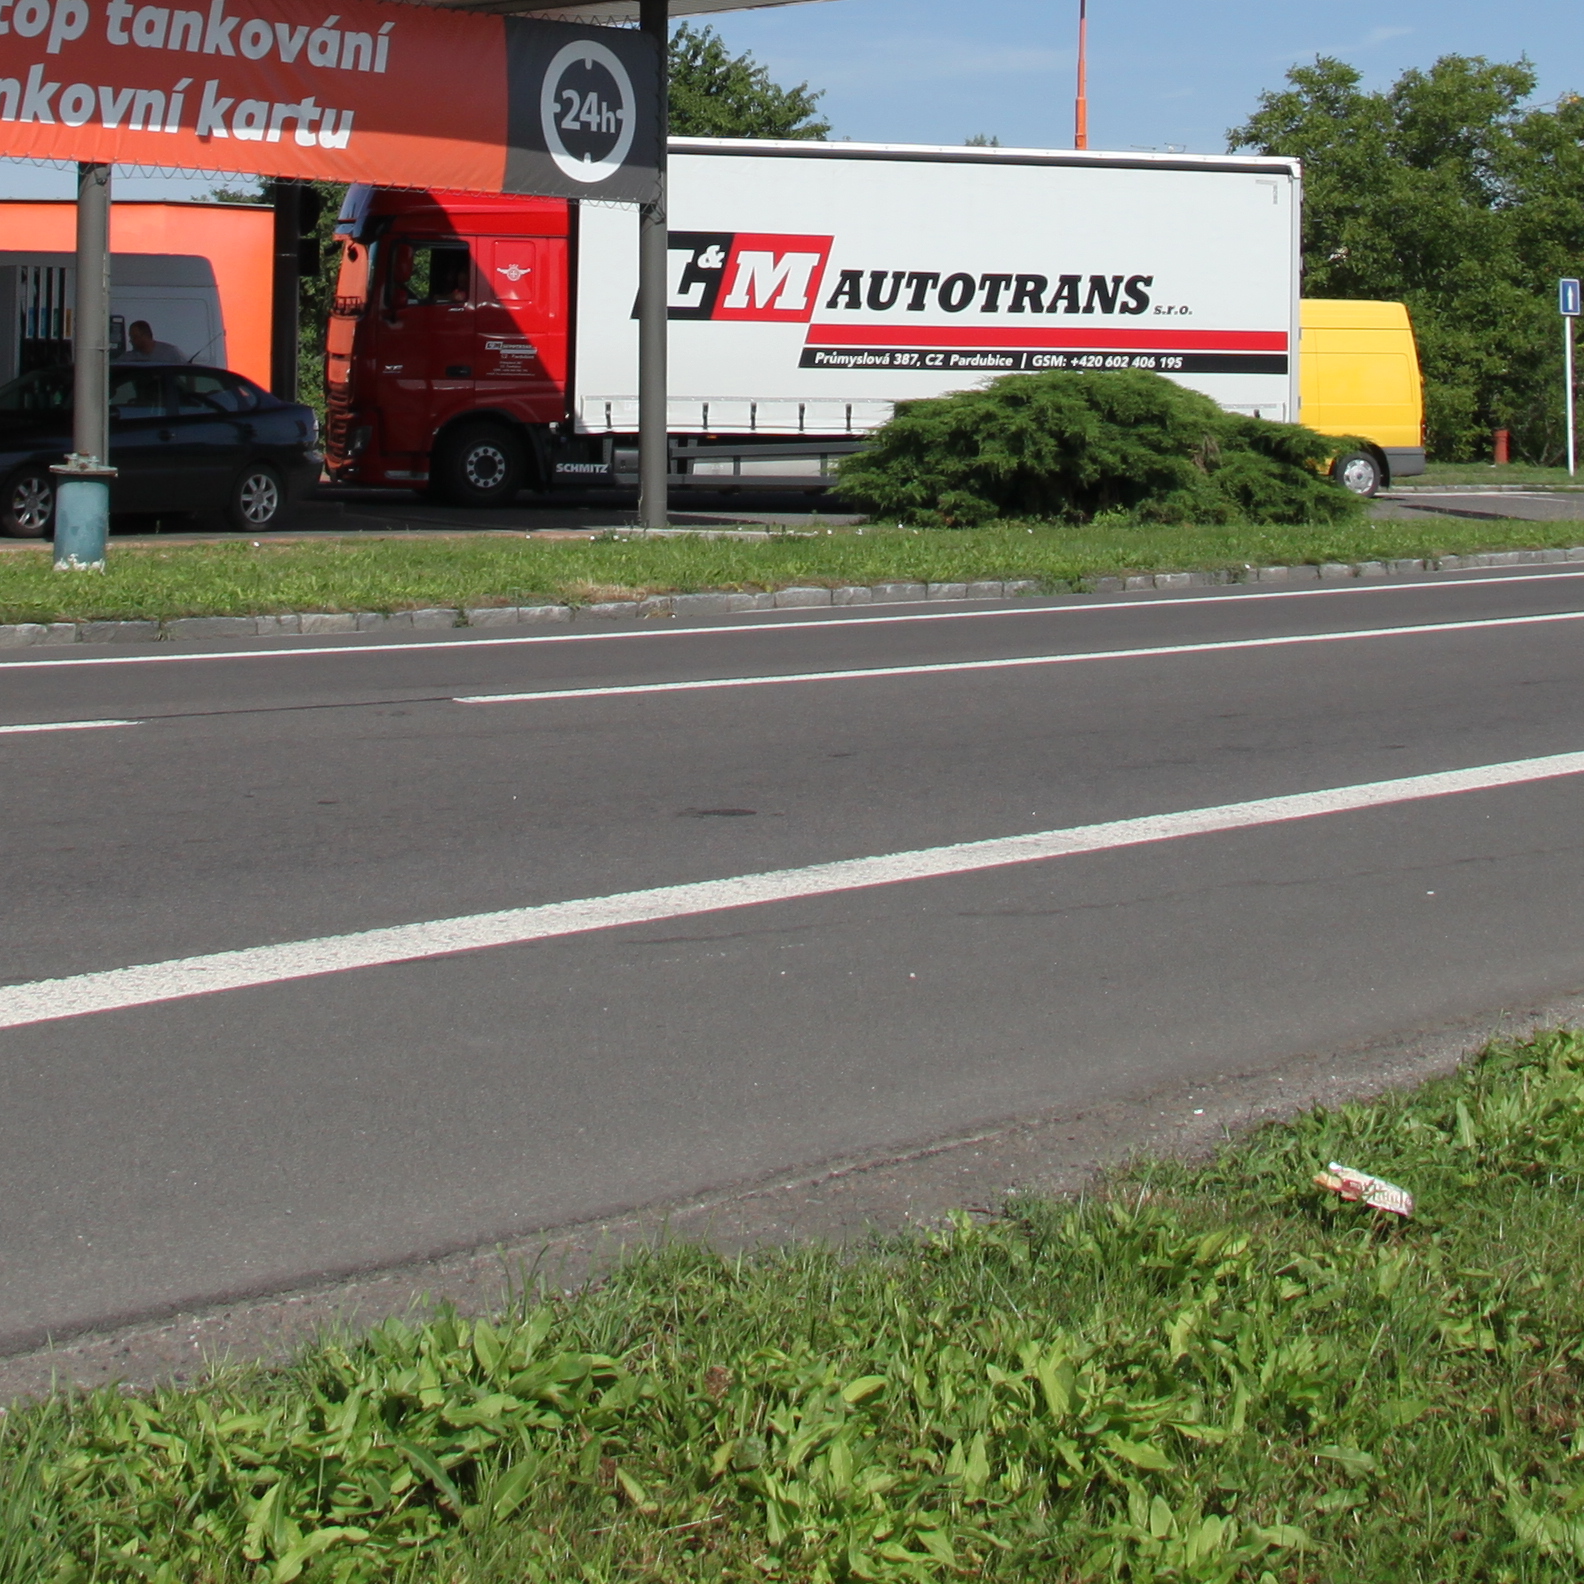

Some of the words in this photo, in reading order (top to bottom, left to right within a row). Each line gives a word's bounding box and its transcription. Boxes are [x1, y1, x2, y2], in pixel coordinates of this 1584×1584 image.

[194, 78, 355, 150] kartu
[561, 89, 615, 134] 24h
[825, 269, 1154, 316] AUTOTRANS
[1154, 303, 1193, 316] s.r.o.
[815, 351, 890, 367] Průmyslová
[893, 353, 921, 367] 387,
[925, 354, 943, 366] CZ
[950, 353, 1013, 367] Pardubice
[1032, 354, 1067, 367] GSM:
[1070, 355, 1103, 368] +420
[1105, 355, 1129, 368] 602
[1132, 356, 1156, 368] 406
[1159, 356, 1183, 369] 195
[556, 463, 610, 474] SCHMITZ
